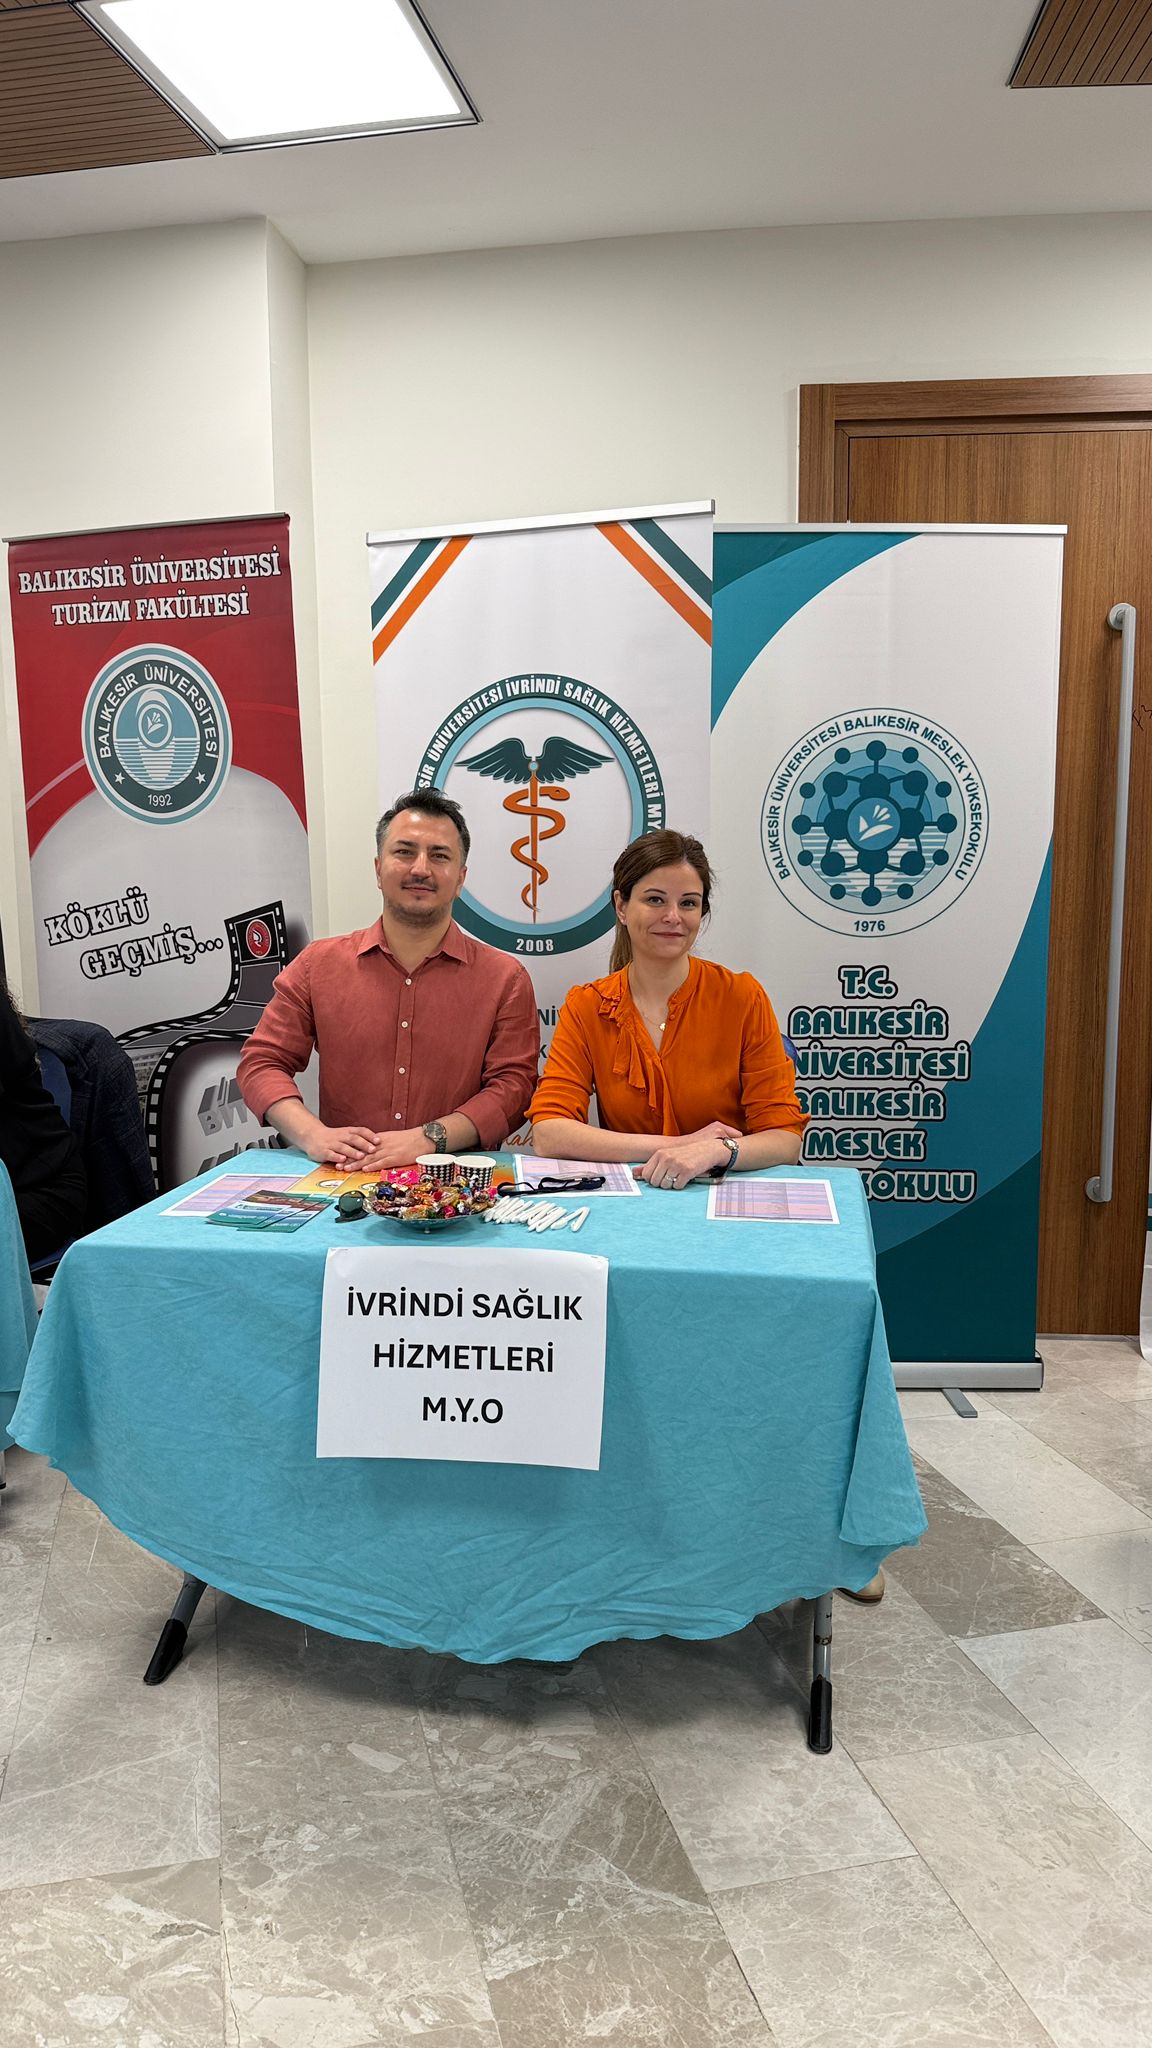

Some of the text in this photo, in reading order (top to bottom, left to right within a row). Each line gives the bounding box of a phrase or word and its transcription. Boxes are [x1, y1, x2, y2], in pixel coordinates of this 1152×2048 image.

[18, 545, 282, 594] BALIKESİR ÜNİVERSİTESİ
[52, 585, 250, 626] TURİZM FAKÜLTESİ
[98, 664, 219, 759] BALIKESİR ÜNİVERSİTESİ
[427, 674, 664, 834] ÜNİVERSİTESİ İVRİNDİ SAĞLIK HİZMETLERİ MY
[147, 794, 173, 807] 1992
[766, 715, 983, 881] BALIKESİR ÜNİVERSİTESİ BALIKESİR MESLEK YÜKSEKOKULU
[44, 886, 150, 946] KÖKLÜ
[853, 919, 886, 932] 1976
[80, 922, 224, 980] GEÇMİŞ...
[516, 938, 554, 952] 2008
[840, 967, 896, 997] T.C.
[791, 1001, 947, 1038] BALIKESİR
[795, 1042, 969, 1079] NİVERSİTESİ
[805, 1129, 926, 1160] MESLEK
[347, 1286, 583, 1321] İVRİNDİ SAĞLIK
[373, 1337, 554, 1373] HİZMETLERİ
[422, 1397, 504, 1424] M.Y.O
